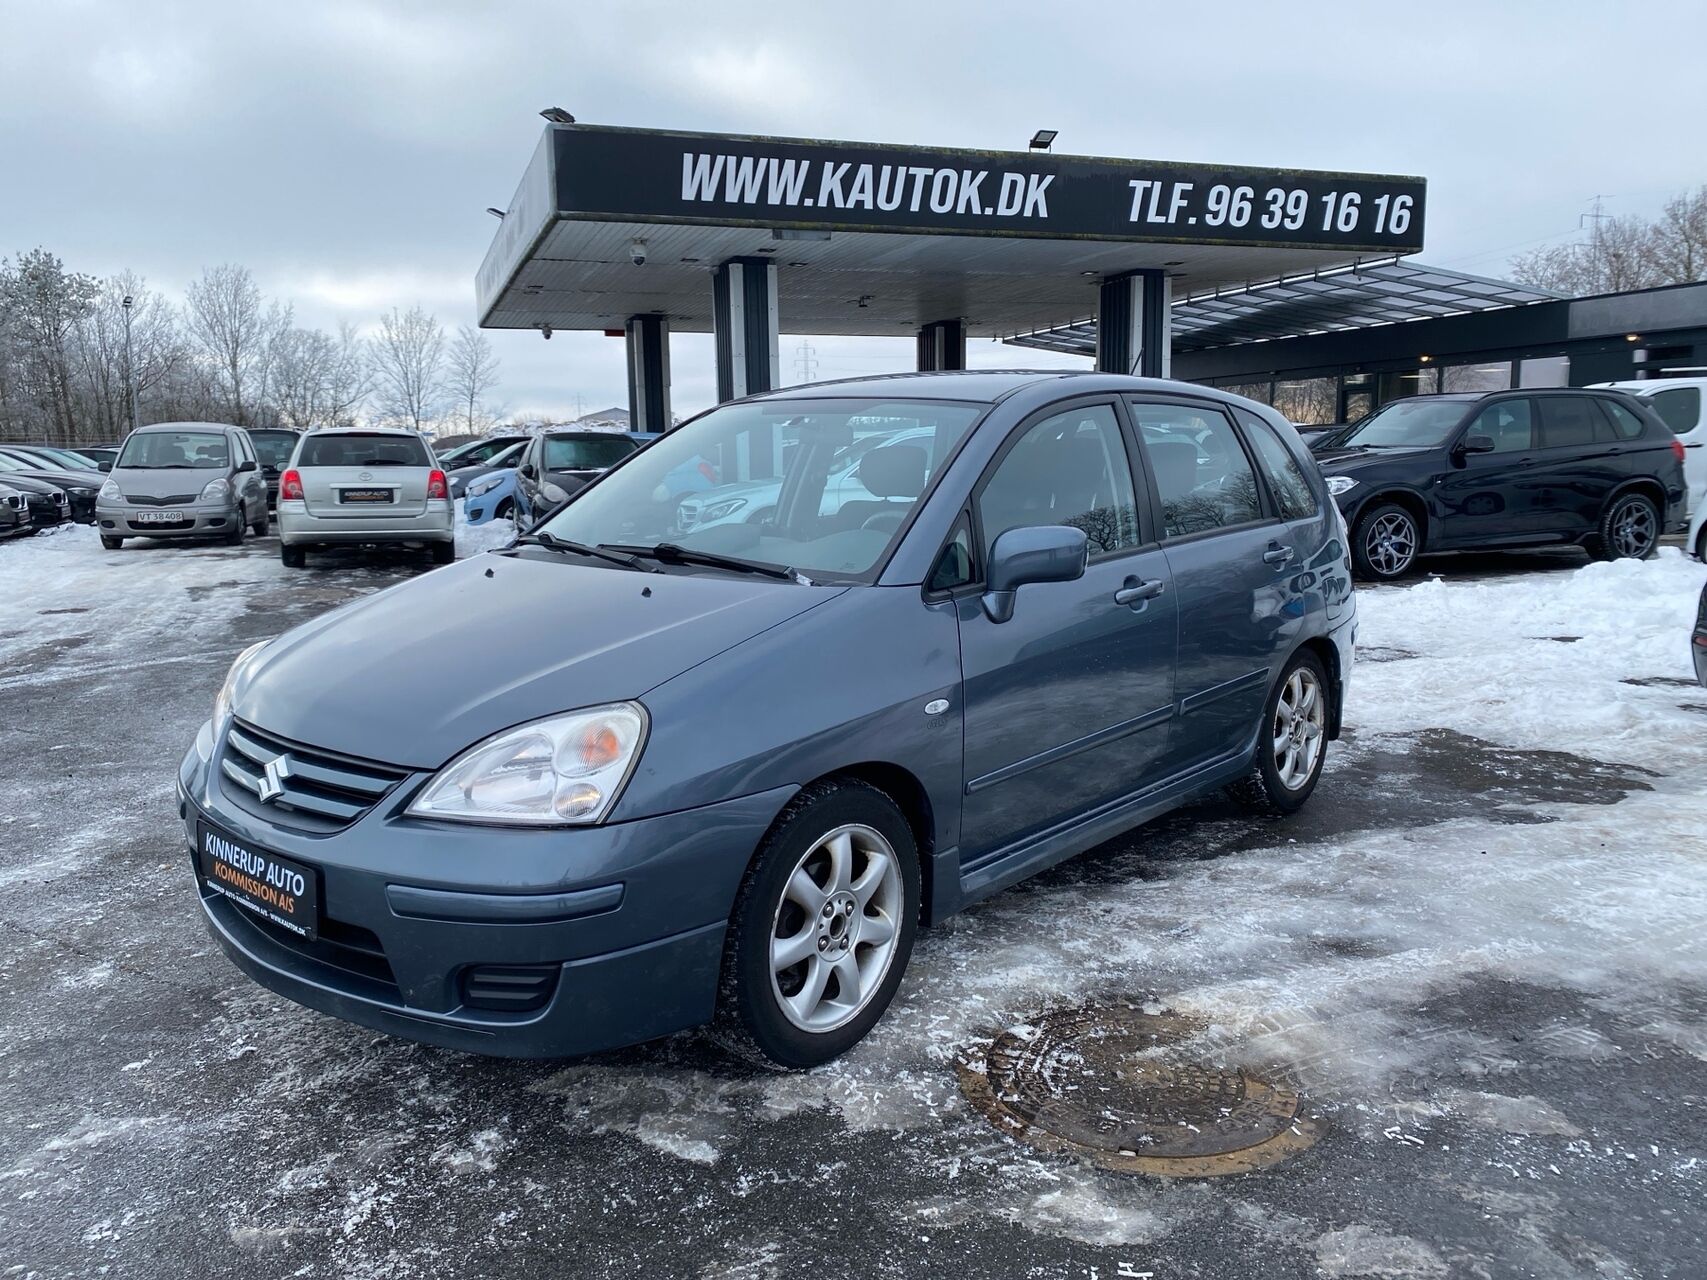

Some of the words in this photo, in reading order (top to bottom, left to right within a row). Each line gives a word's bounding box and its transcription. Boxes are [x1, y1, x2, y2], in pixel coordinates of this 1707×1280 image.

[681, 152, 1056, 218] WWW.KAUTOK.DK
[1128, 179, 1197, 225] TLF.
[1205, 184, 1254, 228] 96
[1261, 188, 1309, 231] 39
[1321, 191, 1362, 232] 16
[1373, 194, 1414, 235] 16
[205, 832, 265, 878] KINNERUP
[266, 862, 305, 897] AUTO
[215, 861, 278, 905] KOMMISSION
